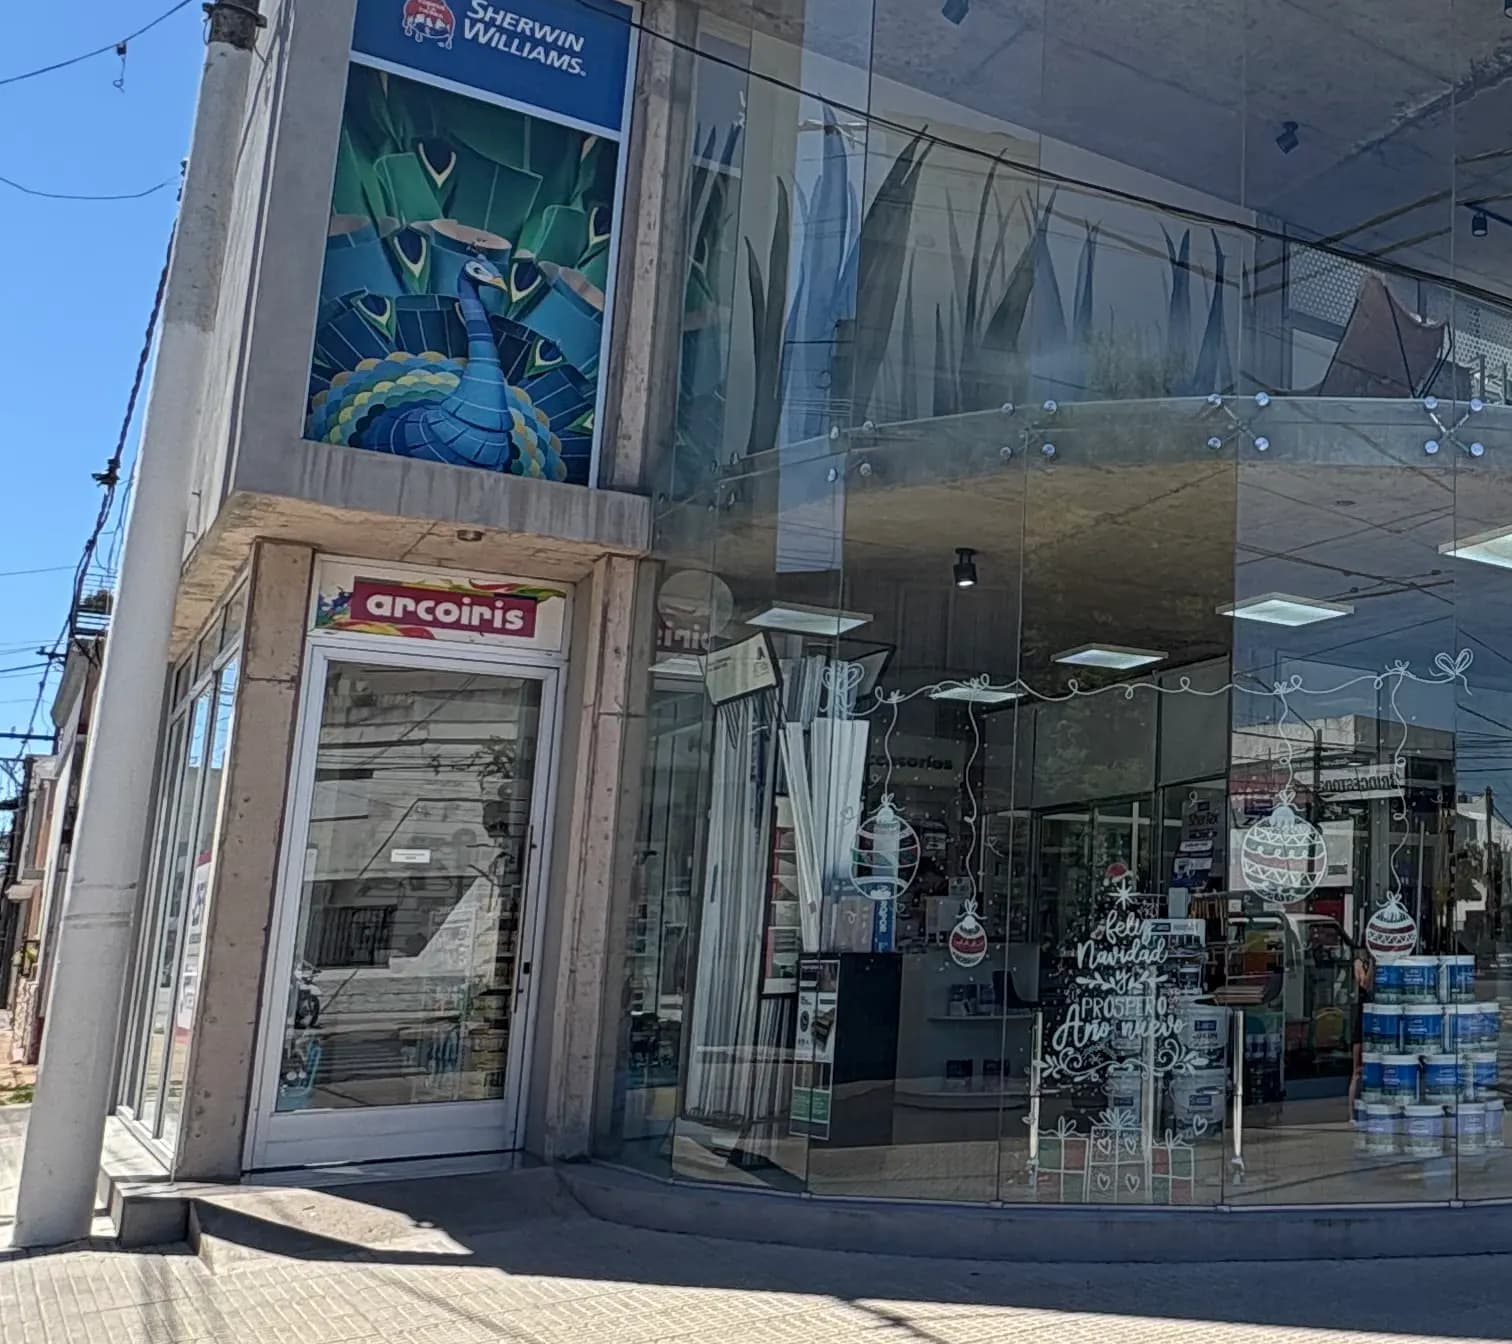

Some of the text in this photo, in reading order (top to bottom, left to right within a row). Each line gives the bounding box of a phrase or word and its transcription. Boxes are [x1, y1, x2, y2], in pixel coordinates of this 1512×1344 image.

[366, 594, 524, 630] arcoiris
[1076, 937, 1168, 969] Navidad
[1121, 1014, 1189, 1040] nuevo
